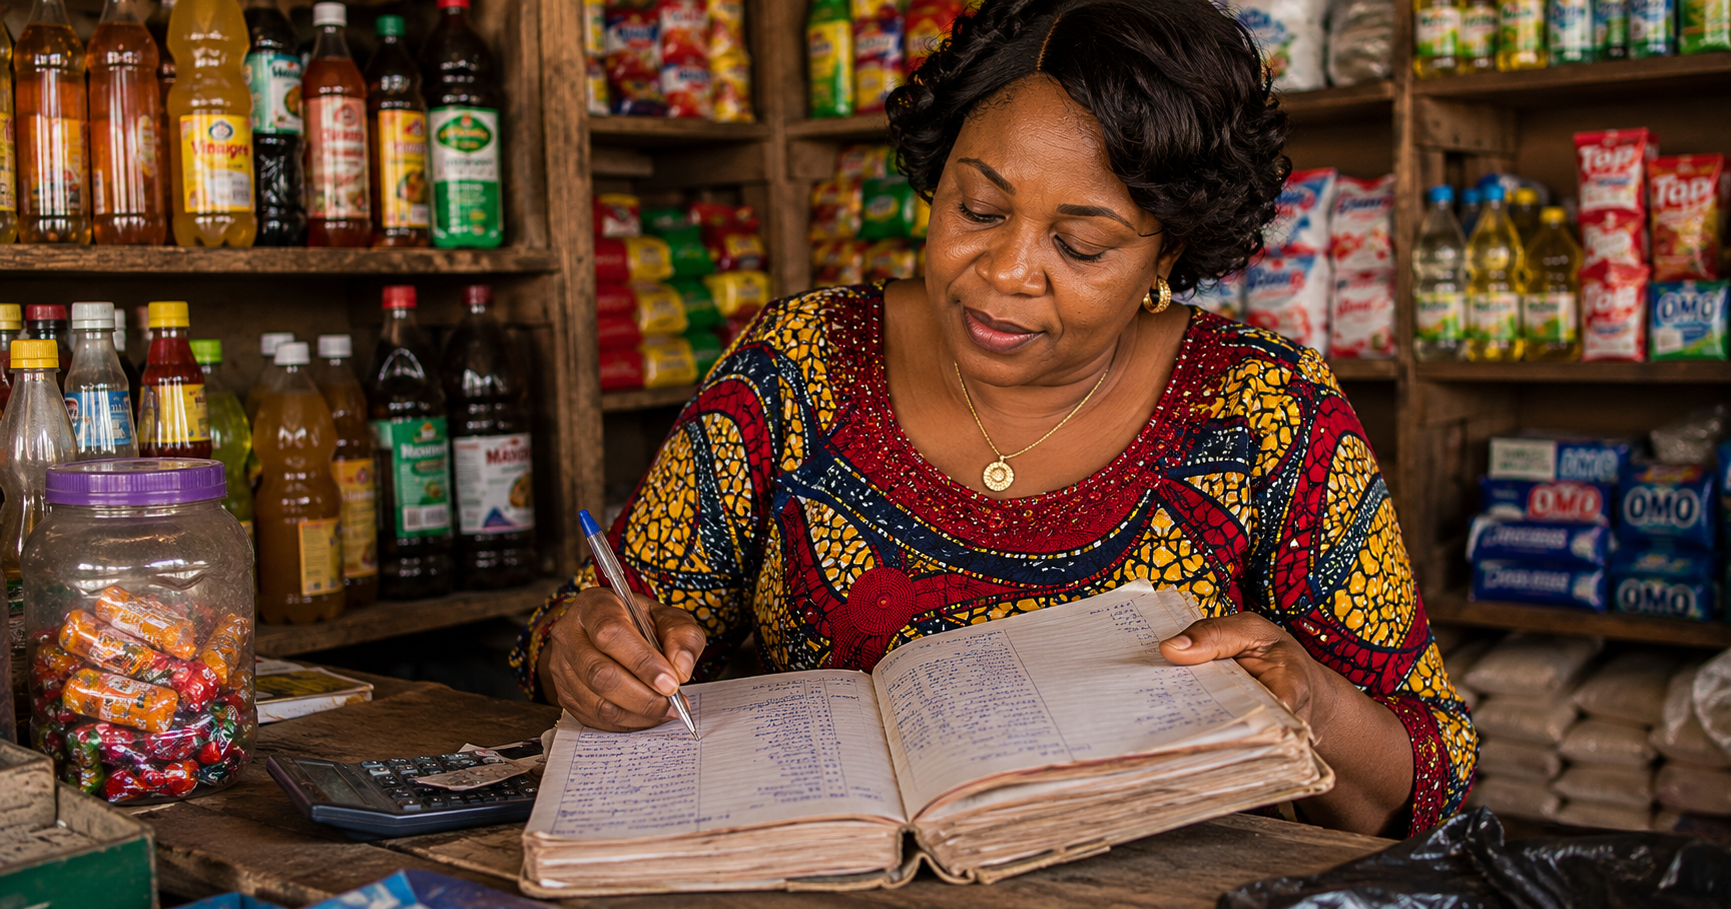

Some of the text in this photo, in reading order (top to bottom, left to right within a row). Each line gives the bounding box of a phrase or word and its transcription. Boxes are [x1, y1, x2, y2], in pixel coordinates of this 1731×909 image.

[1579, 144, 1634, 174] Top
[1652, 173, 1712, 208] Top
[1657, 291, 1716, 325] OMO
[1528, 484, 1602, 520] OMO
[1624, 486, 1701, 528] OMO
[1617, 578, 1696, 617] OMO
